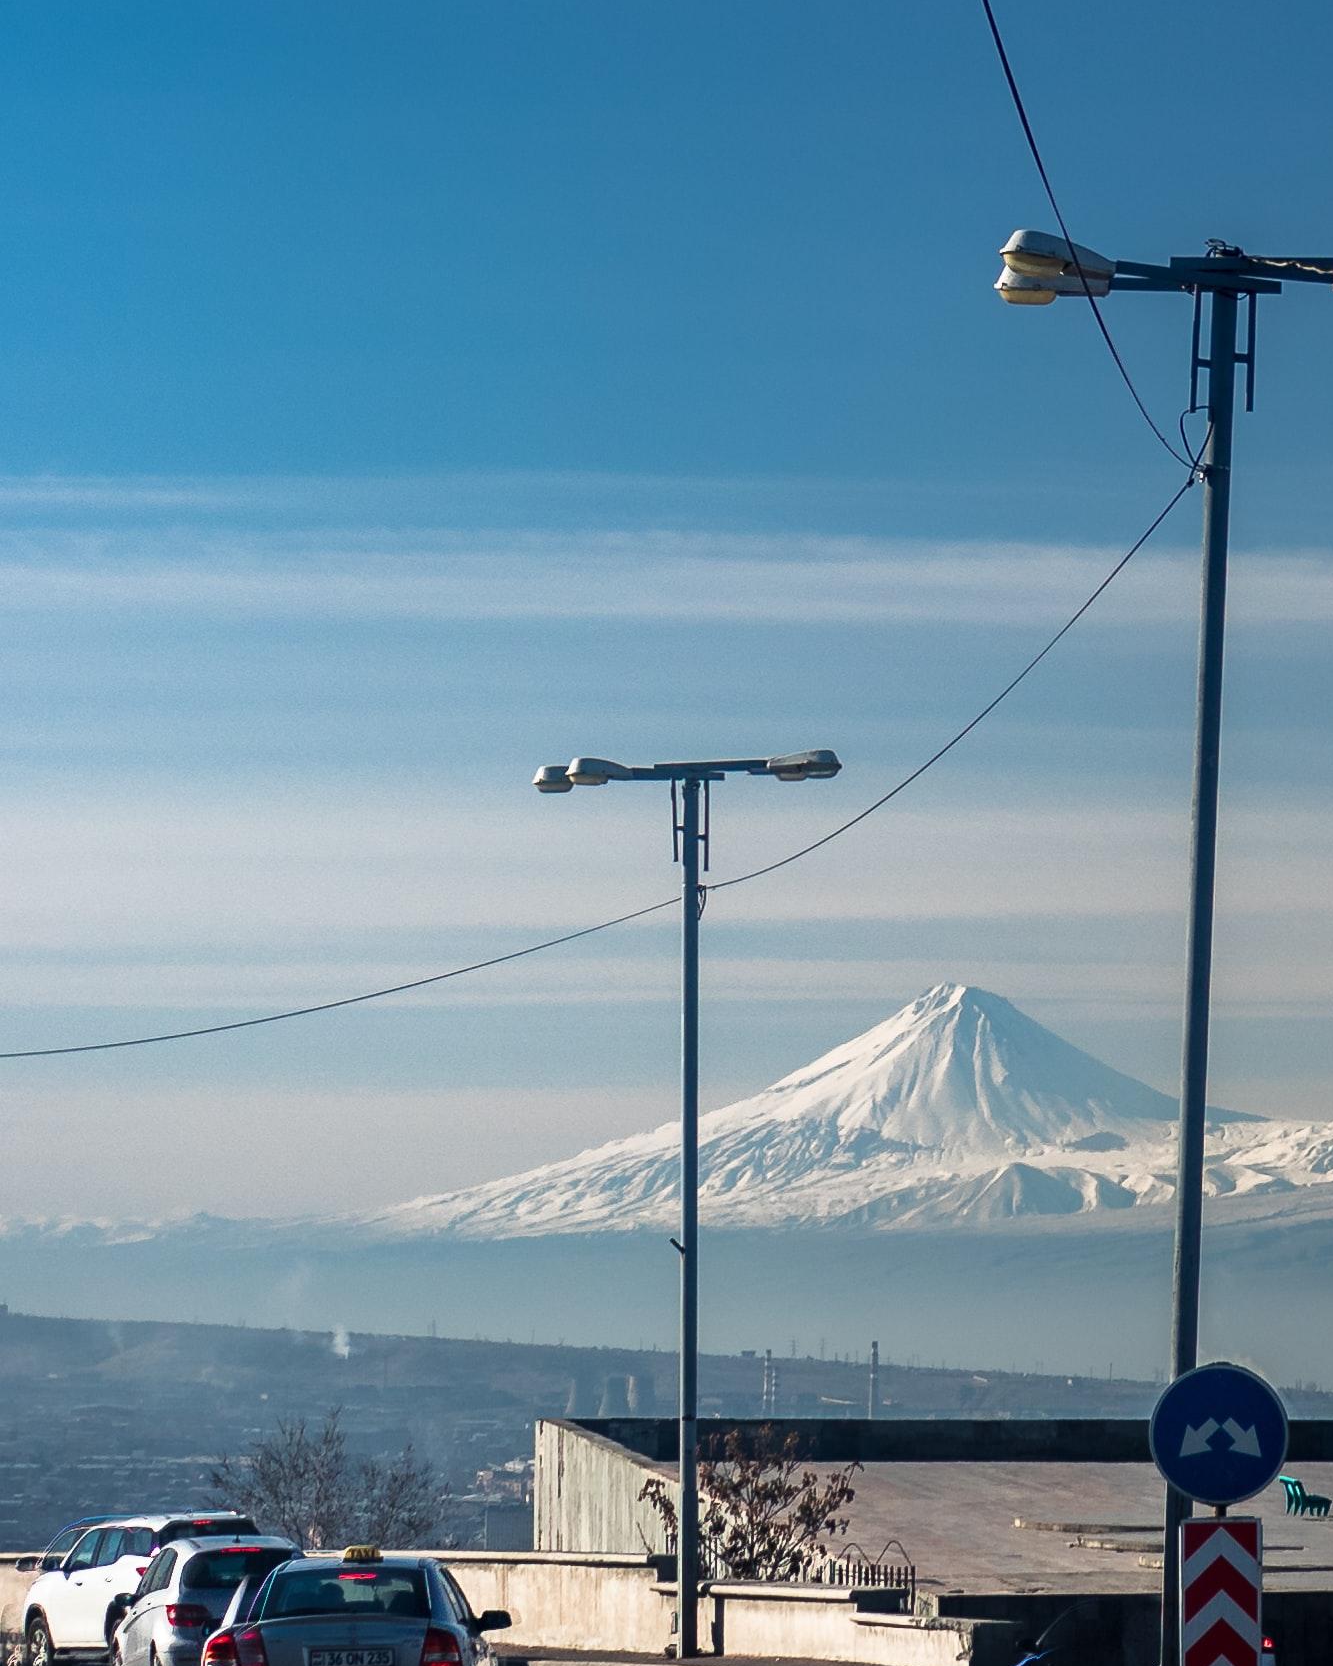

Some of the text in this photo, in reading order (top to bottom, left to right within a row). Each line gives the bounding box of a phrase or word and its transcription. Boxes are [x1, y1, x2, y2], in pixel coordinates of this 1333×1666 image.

[350, 1548, 377, 1558] TAXI
[327, 1652, 342, 1665] 36
[367, 1651, 390, 1664] 235
